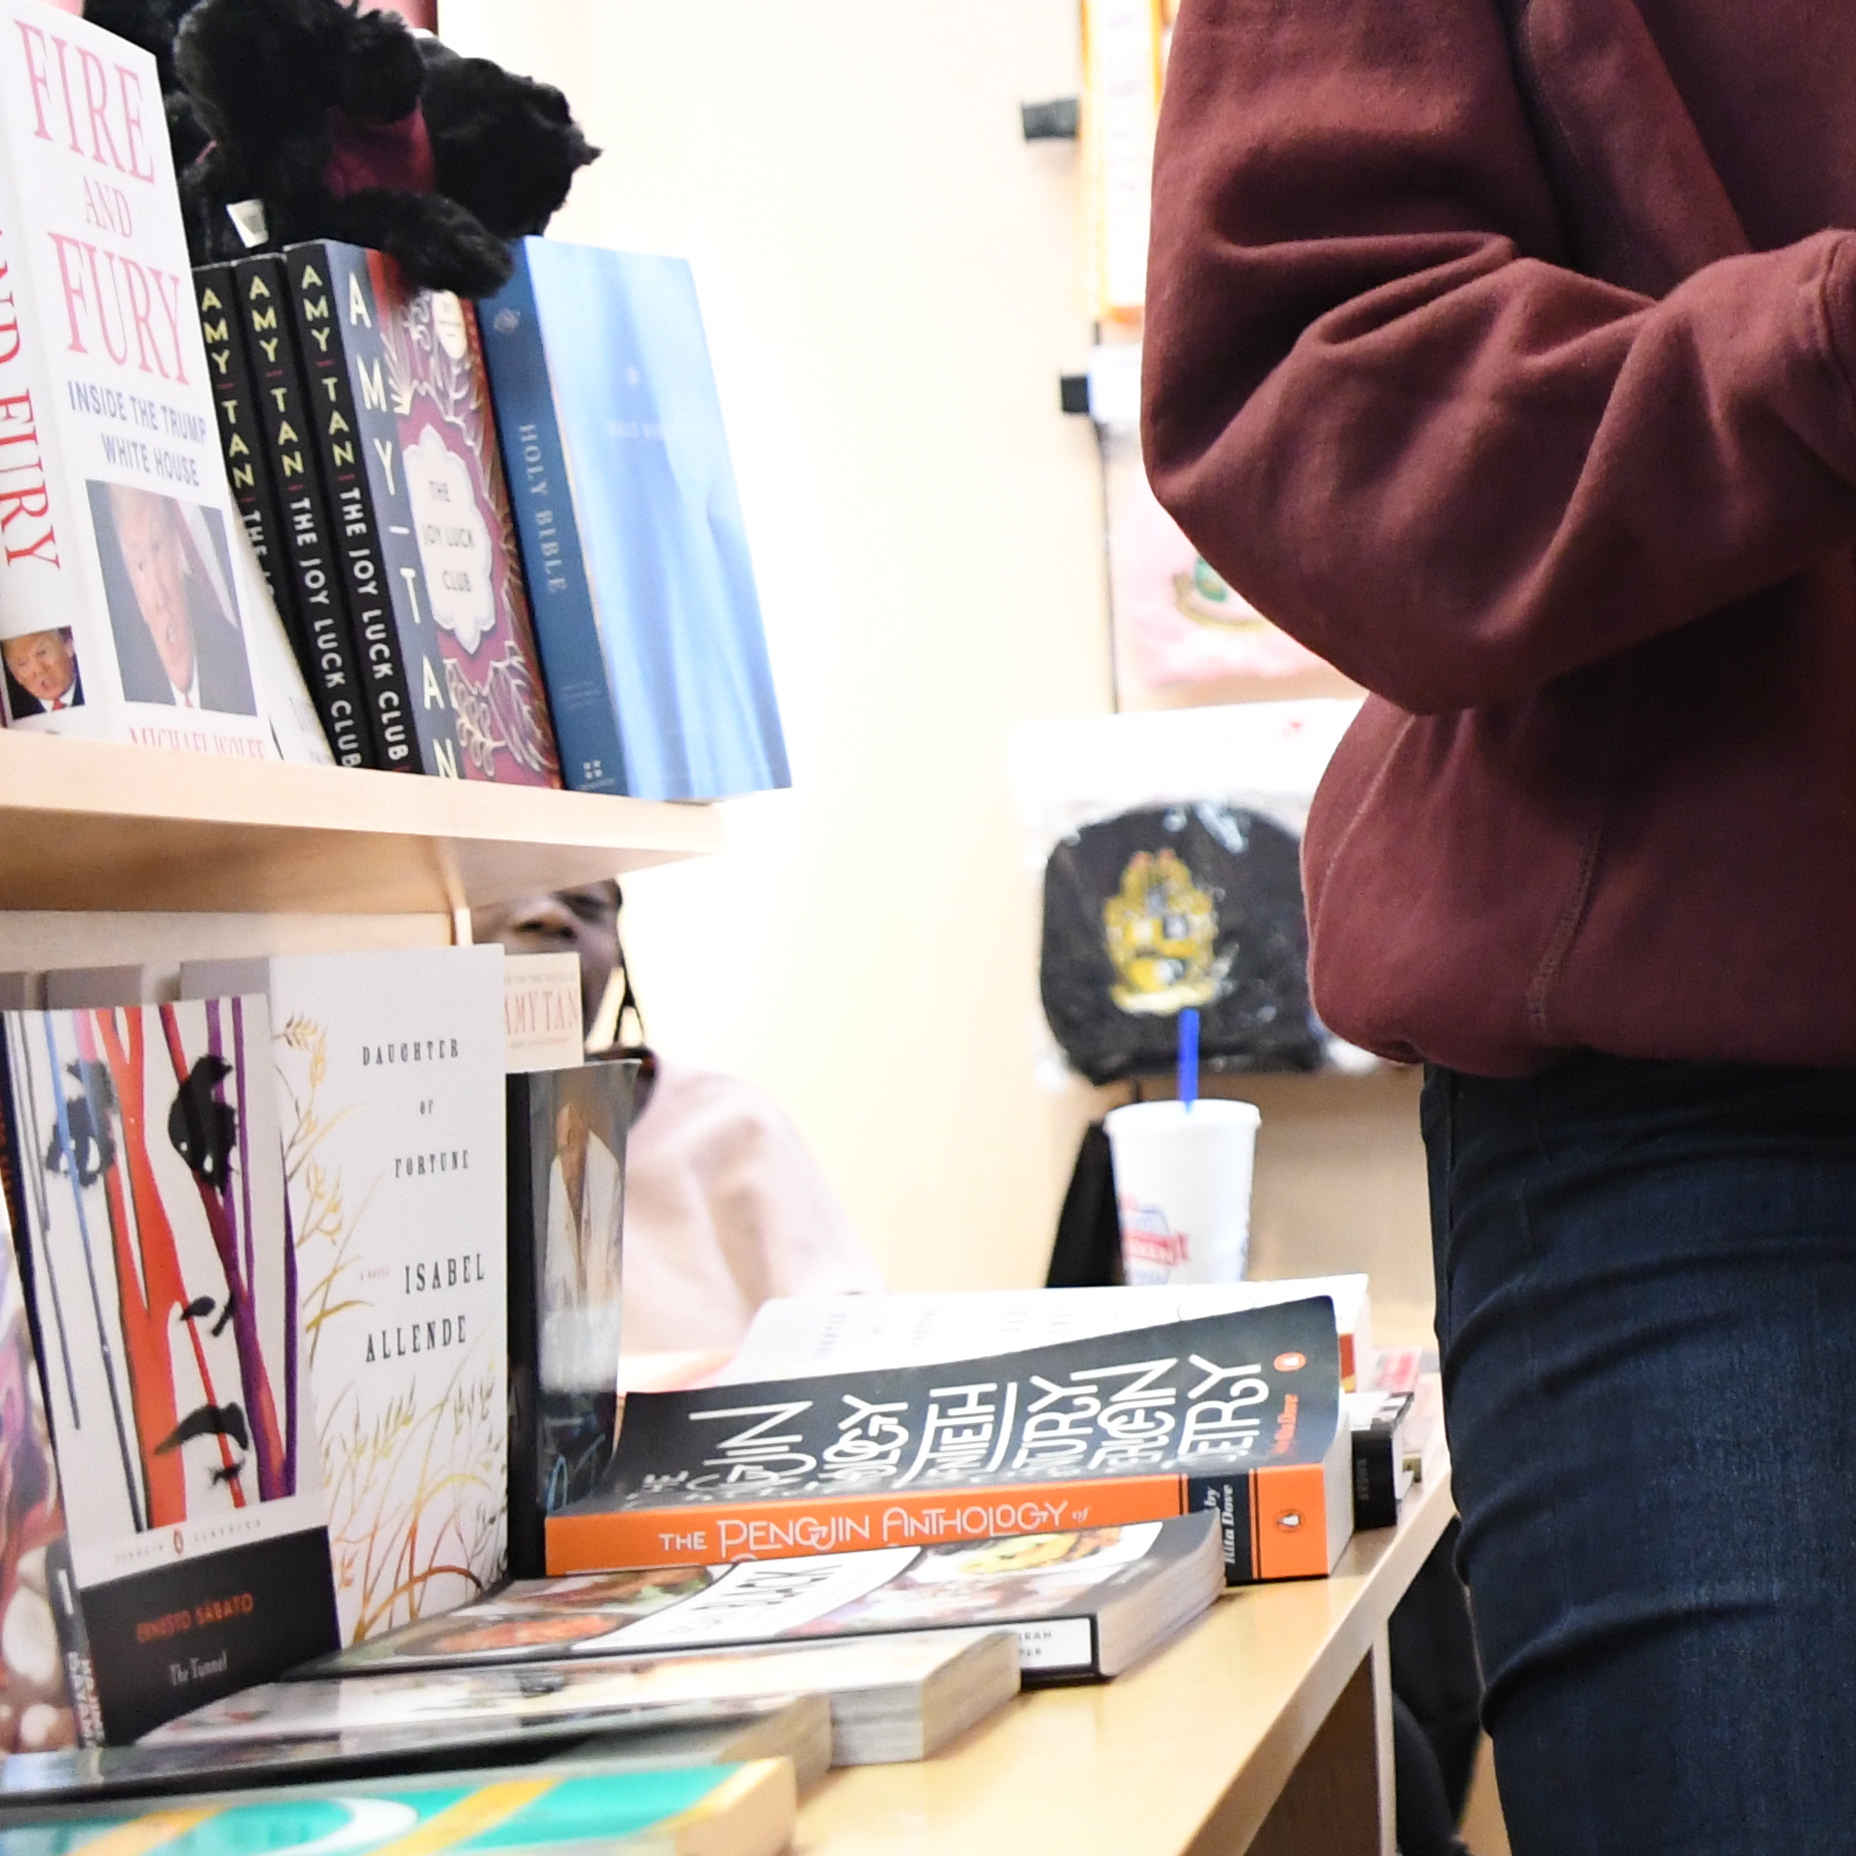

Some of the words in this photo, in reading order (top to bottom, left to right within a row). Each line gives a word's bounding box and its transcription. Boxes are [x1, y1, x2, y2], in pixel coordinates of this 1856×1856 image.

[14, 19, 155, 184] FIRE
[83, 175, 132, 238] AND
[48, 232, 190, 385] FURY
[250, 275, 278, 363] AMY
[302, 264, 330, 352] AMY
[68, 381, 126, 421] INSIDE
[129, 398, 159, 430] THE
[161, 406, 206, 445] TRUMP
[201, 287, 230, 375] AMY
[221, 399, 255, 489] TAN
[270, 387, 304, 477] TAN
[322, 376, 355, 467] TAN
[100, 433, 150, 474] WHITE
[155, 448, 199, 486] HOUSE
[290, 497, 318, 547] THE
[340, 487, 368, 537] THE
[518, 423, 547, 497] HOLY
[534, 508, 568, 594] BIBLE
[299, 558, 331, 605] JOY
[348, 548, 379, 596] JOY
[313, 618, 346, 689] LUCK
[362, 608, 394, 680] LUCK
[331, 700, 363, 768] CLUB
[378, 691, 409, 761] CLUB
[362, 1038, 459, 1066] DAUGHTER
[419, 1100, 434, 1116] OF
[395, 1149, 469, 1179] FORTUNE
[404, 1253, 485, 1295] ISABEL
[365, 1315, 468, 1363] ALLENDE
[659, 1531, 708, 1551] THE
[716, 1515, 870, 1559] PENGUIN
[882, 1500, 1068, 1542] ANTHOLOGY
[1221, 1485, 1235, 1528] Dove
[189, 1649, 228, 1680] Tunnel
